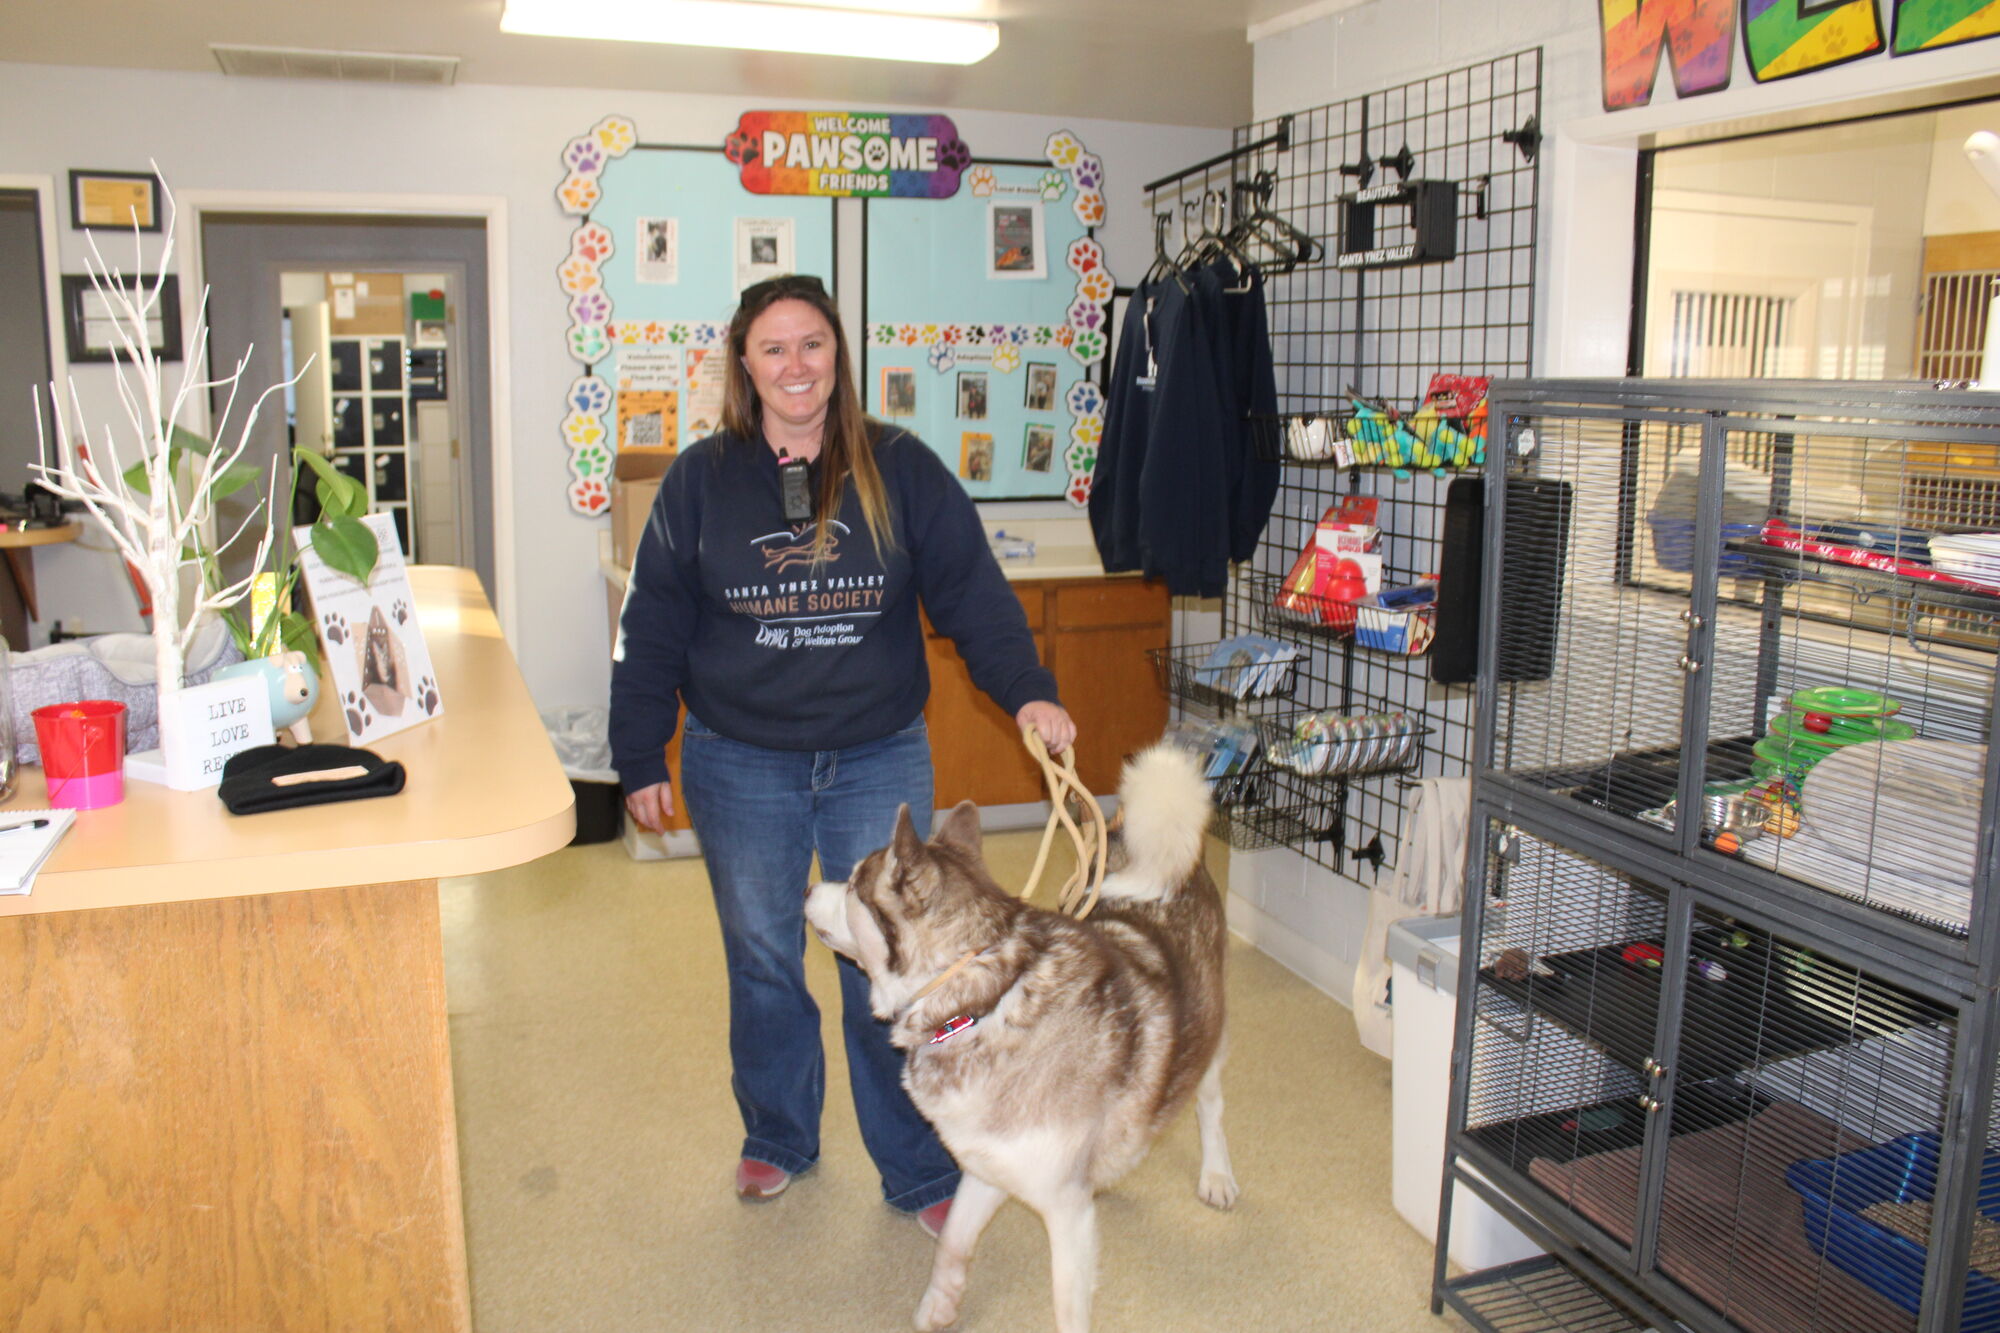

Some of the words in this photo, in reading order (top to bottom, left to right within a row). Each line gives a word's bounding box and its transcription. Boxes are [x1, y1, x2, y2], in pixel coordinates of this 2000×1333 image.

[815, 117, 891, 134] WELCOME
[762, 131, 939, 171] PAWSOME
[819, 173, 889, 191] FRIENDS
[1356, 184, 1400, 204] BEAUTIFUL
[1338, 252, 1364, 268] SANTA
[1364, 248, 1386, 265] YNEZ
[1386, 244, 1415, 261] VALLEY
[725, 585, 769, 599] SANTA
[779, 580, 818, 594] YNEZ
[828, 575, 885, 590] VALLEY
[729, 596, 800, 616] HUMANE
[808, 590, 885, 612] SOCIETY
[793, 626, 812, 638] Dog
[813, 622, 855, 635] Adoption
[805, 635, 837, 647] Welfare
[208, 697, 247, 721] LIVE
[211, 723, 250, 747] LOVE
